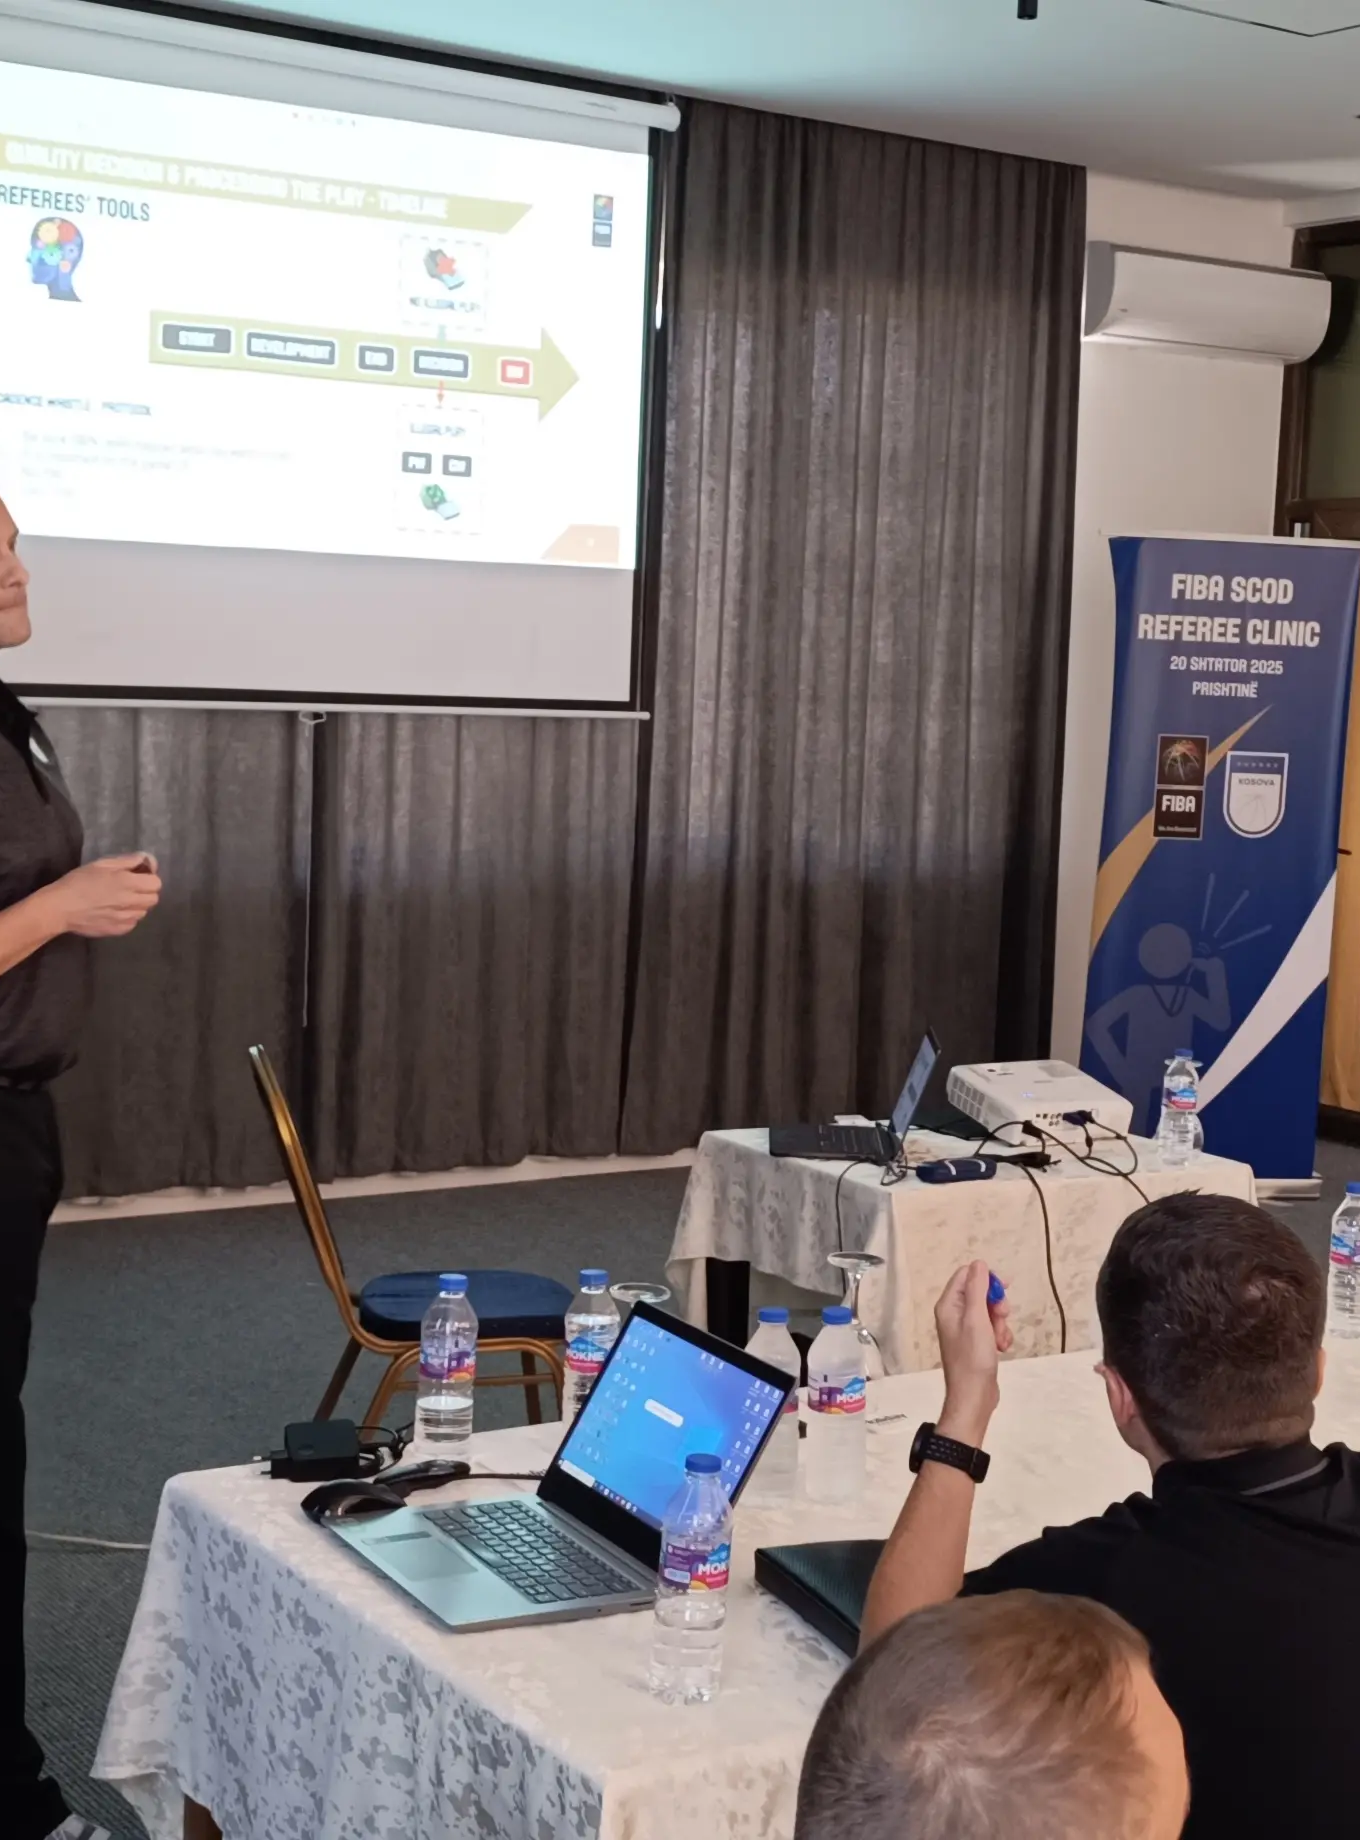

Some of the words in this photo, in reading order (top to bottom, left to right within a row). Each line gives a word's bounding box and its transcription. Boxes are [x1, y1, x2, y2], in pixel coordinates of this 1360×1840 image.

[97, 196, 150, 222] TOOLS
[1171, 573, 1224, 602] FIBA
[1230, 576, 1294, 605] SCOD
[1138, 613, 1241, 644] REFEREE
[1247, 617, 1321, 648] CLINIC
[1170, 655, 1187, 671] 20
[1190, 656, 1247, 674] SHTATOR
[1250, 659, 1284, 675] 2025
[1192, 680, 1258, 699] PRISHTINË
[1238, 777, 1276, 787] KOSOVA
[1161, 794, 1196, 813] FIBA
